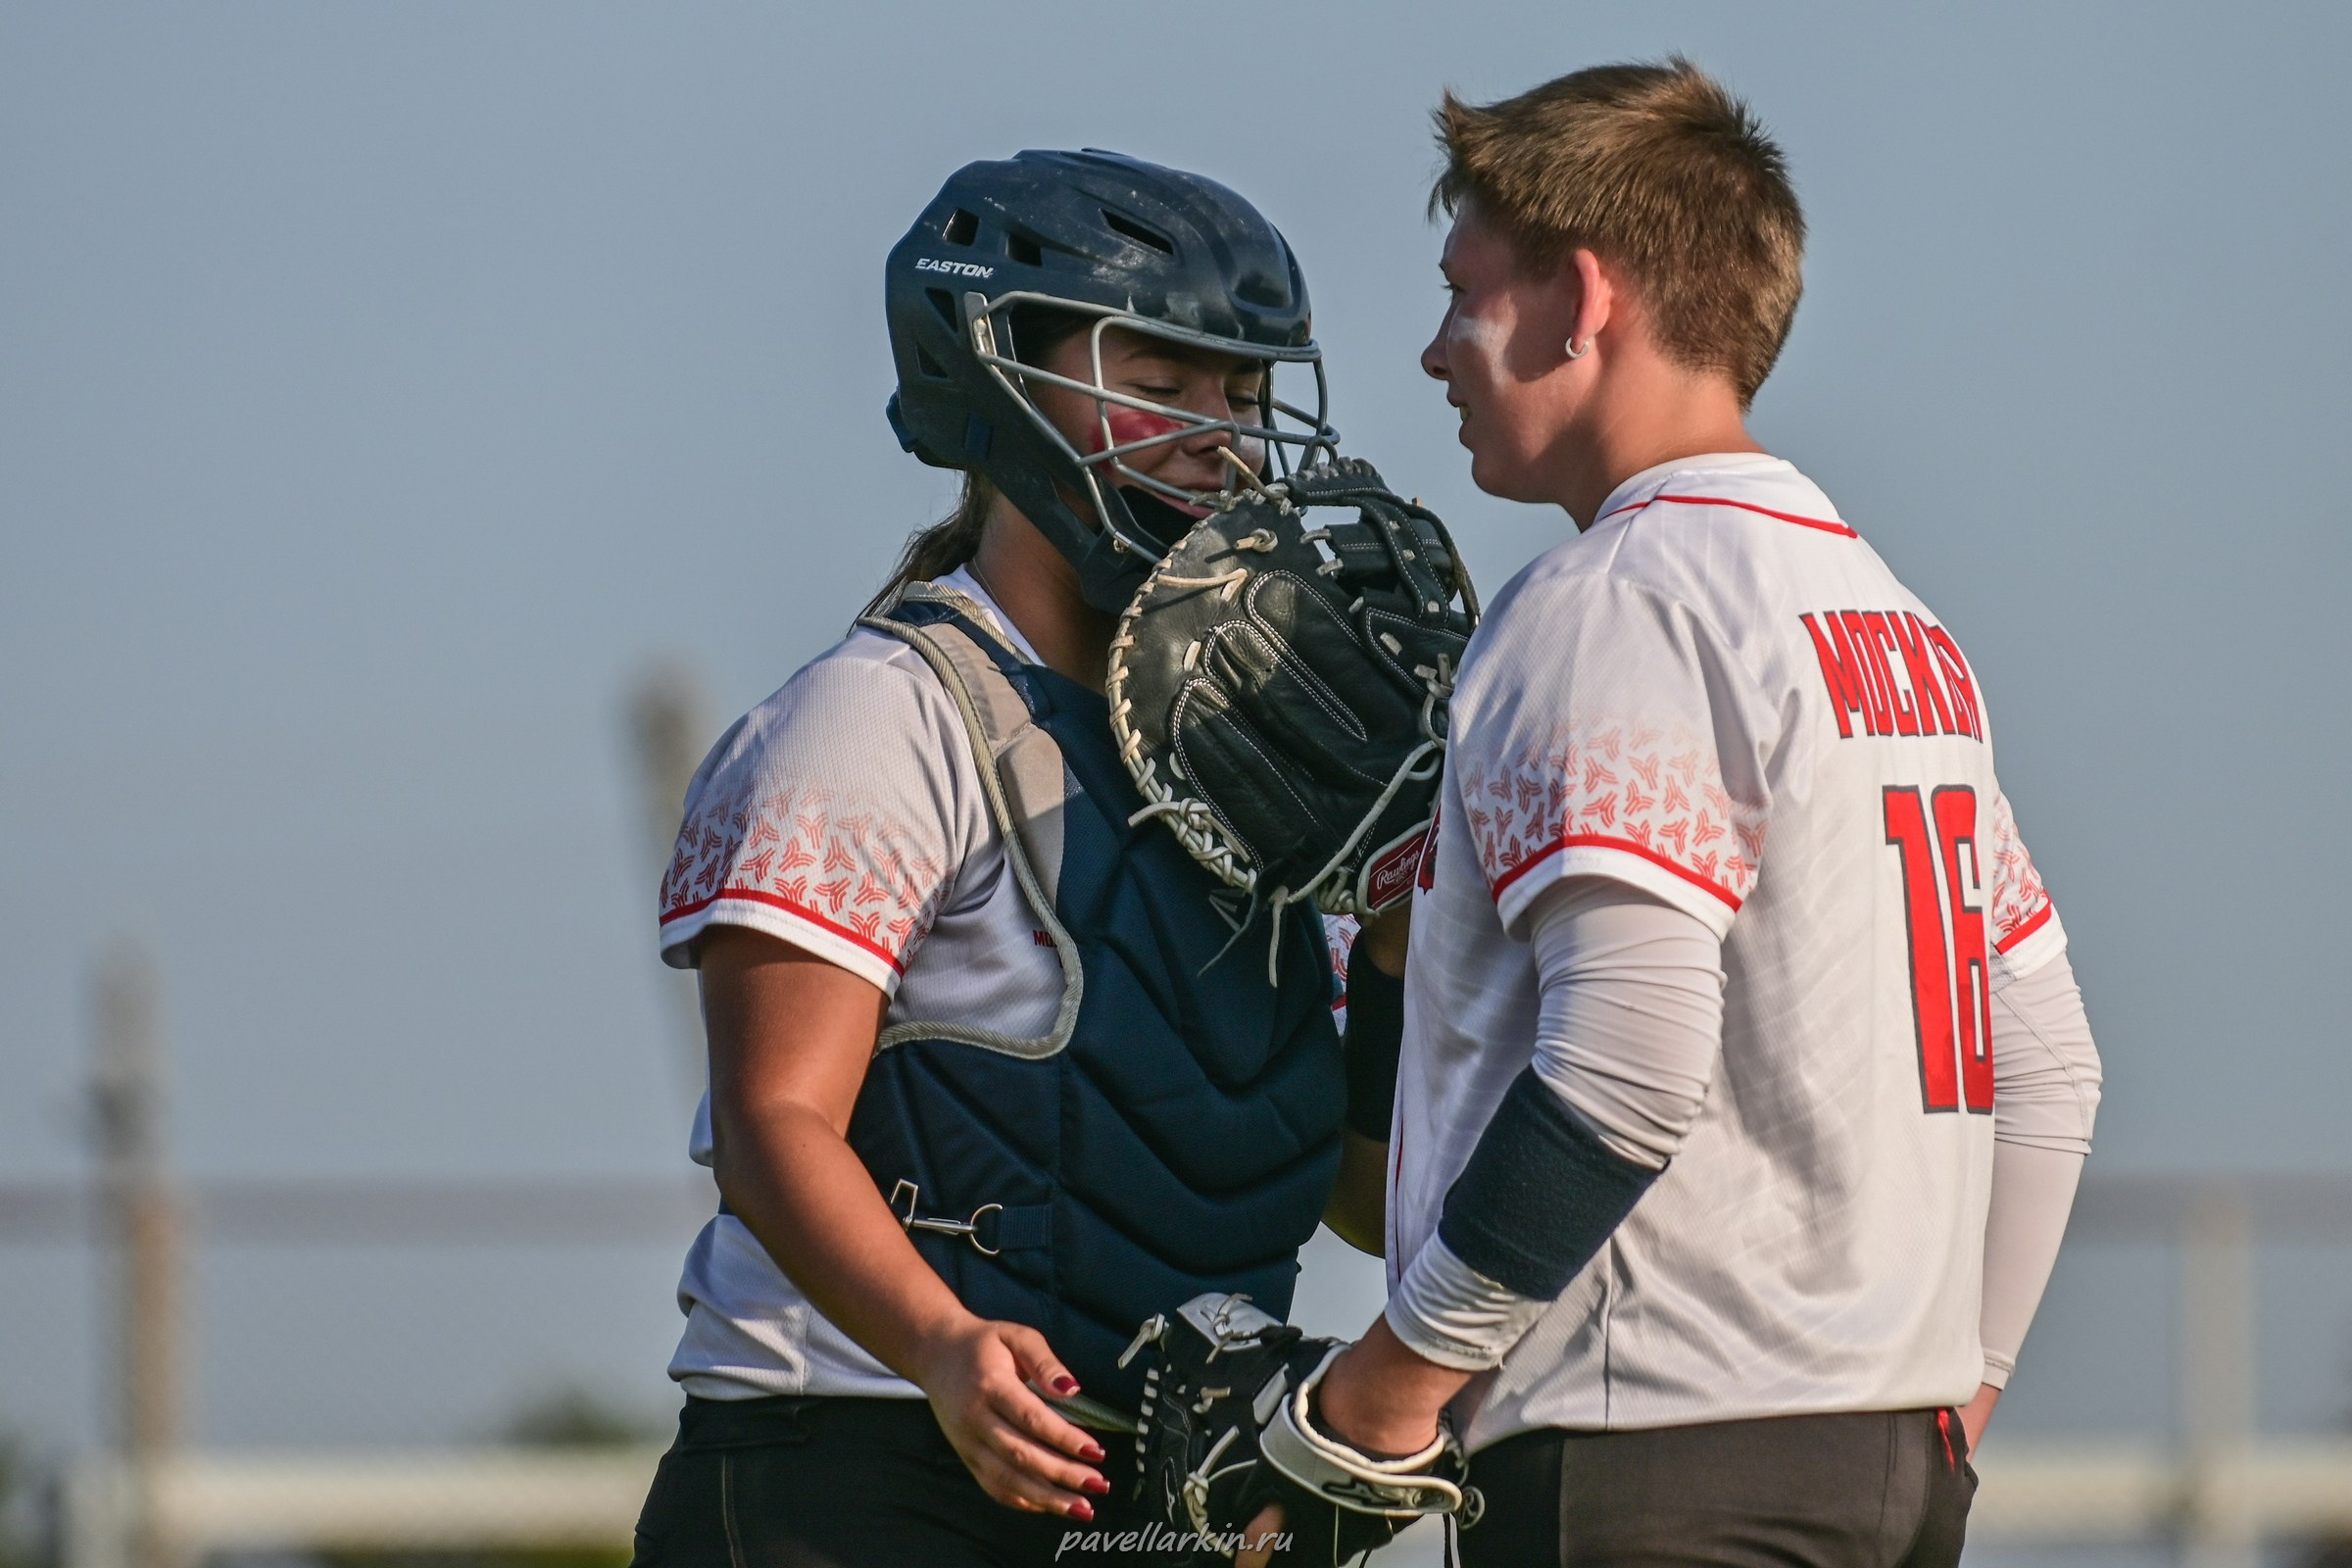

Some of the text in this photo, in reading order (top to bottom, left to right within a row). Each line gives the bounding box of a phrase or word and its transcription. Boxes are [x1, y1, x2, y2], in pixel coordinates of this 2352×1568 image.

[915, 258, 994, 278] EASTON
[1376, 850, 1421, 891] Rawlings
[1883, 784, 1995, 1114] 16
